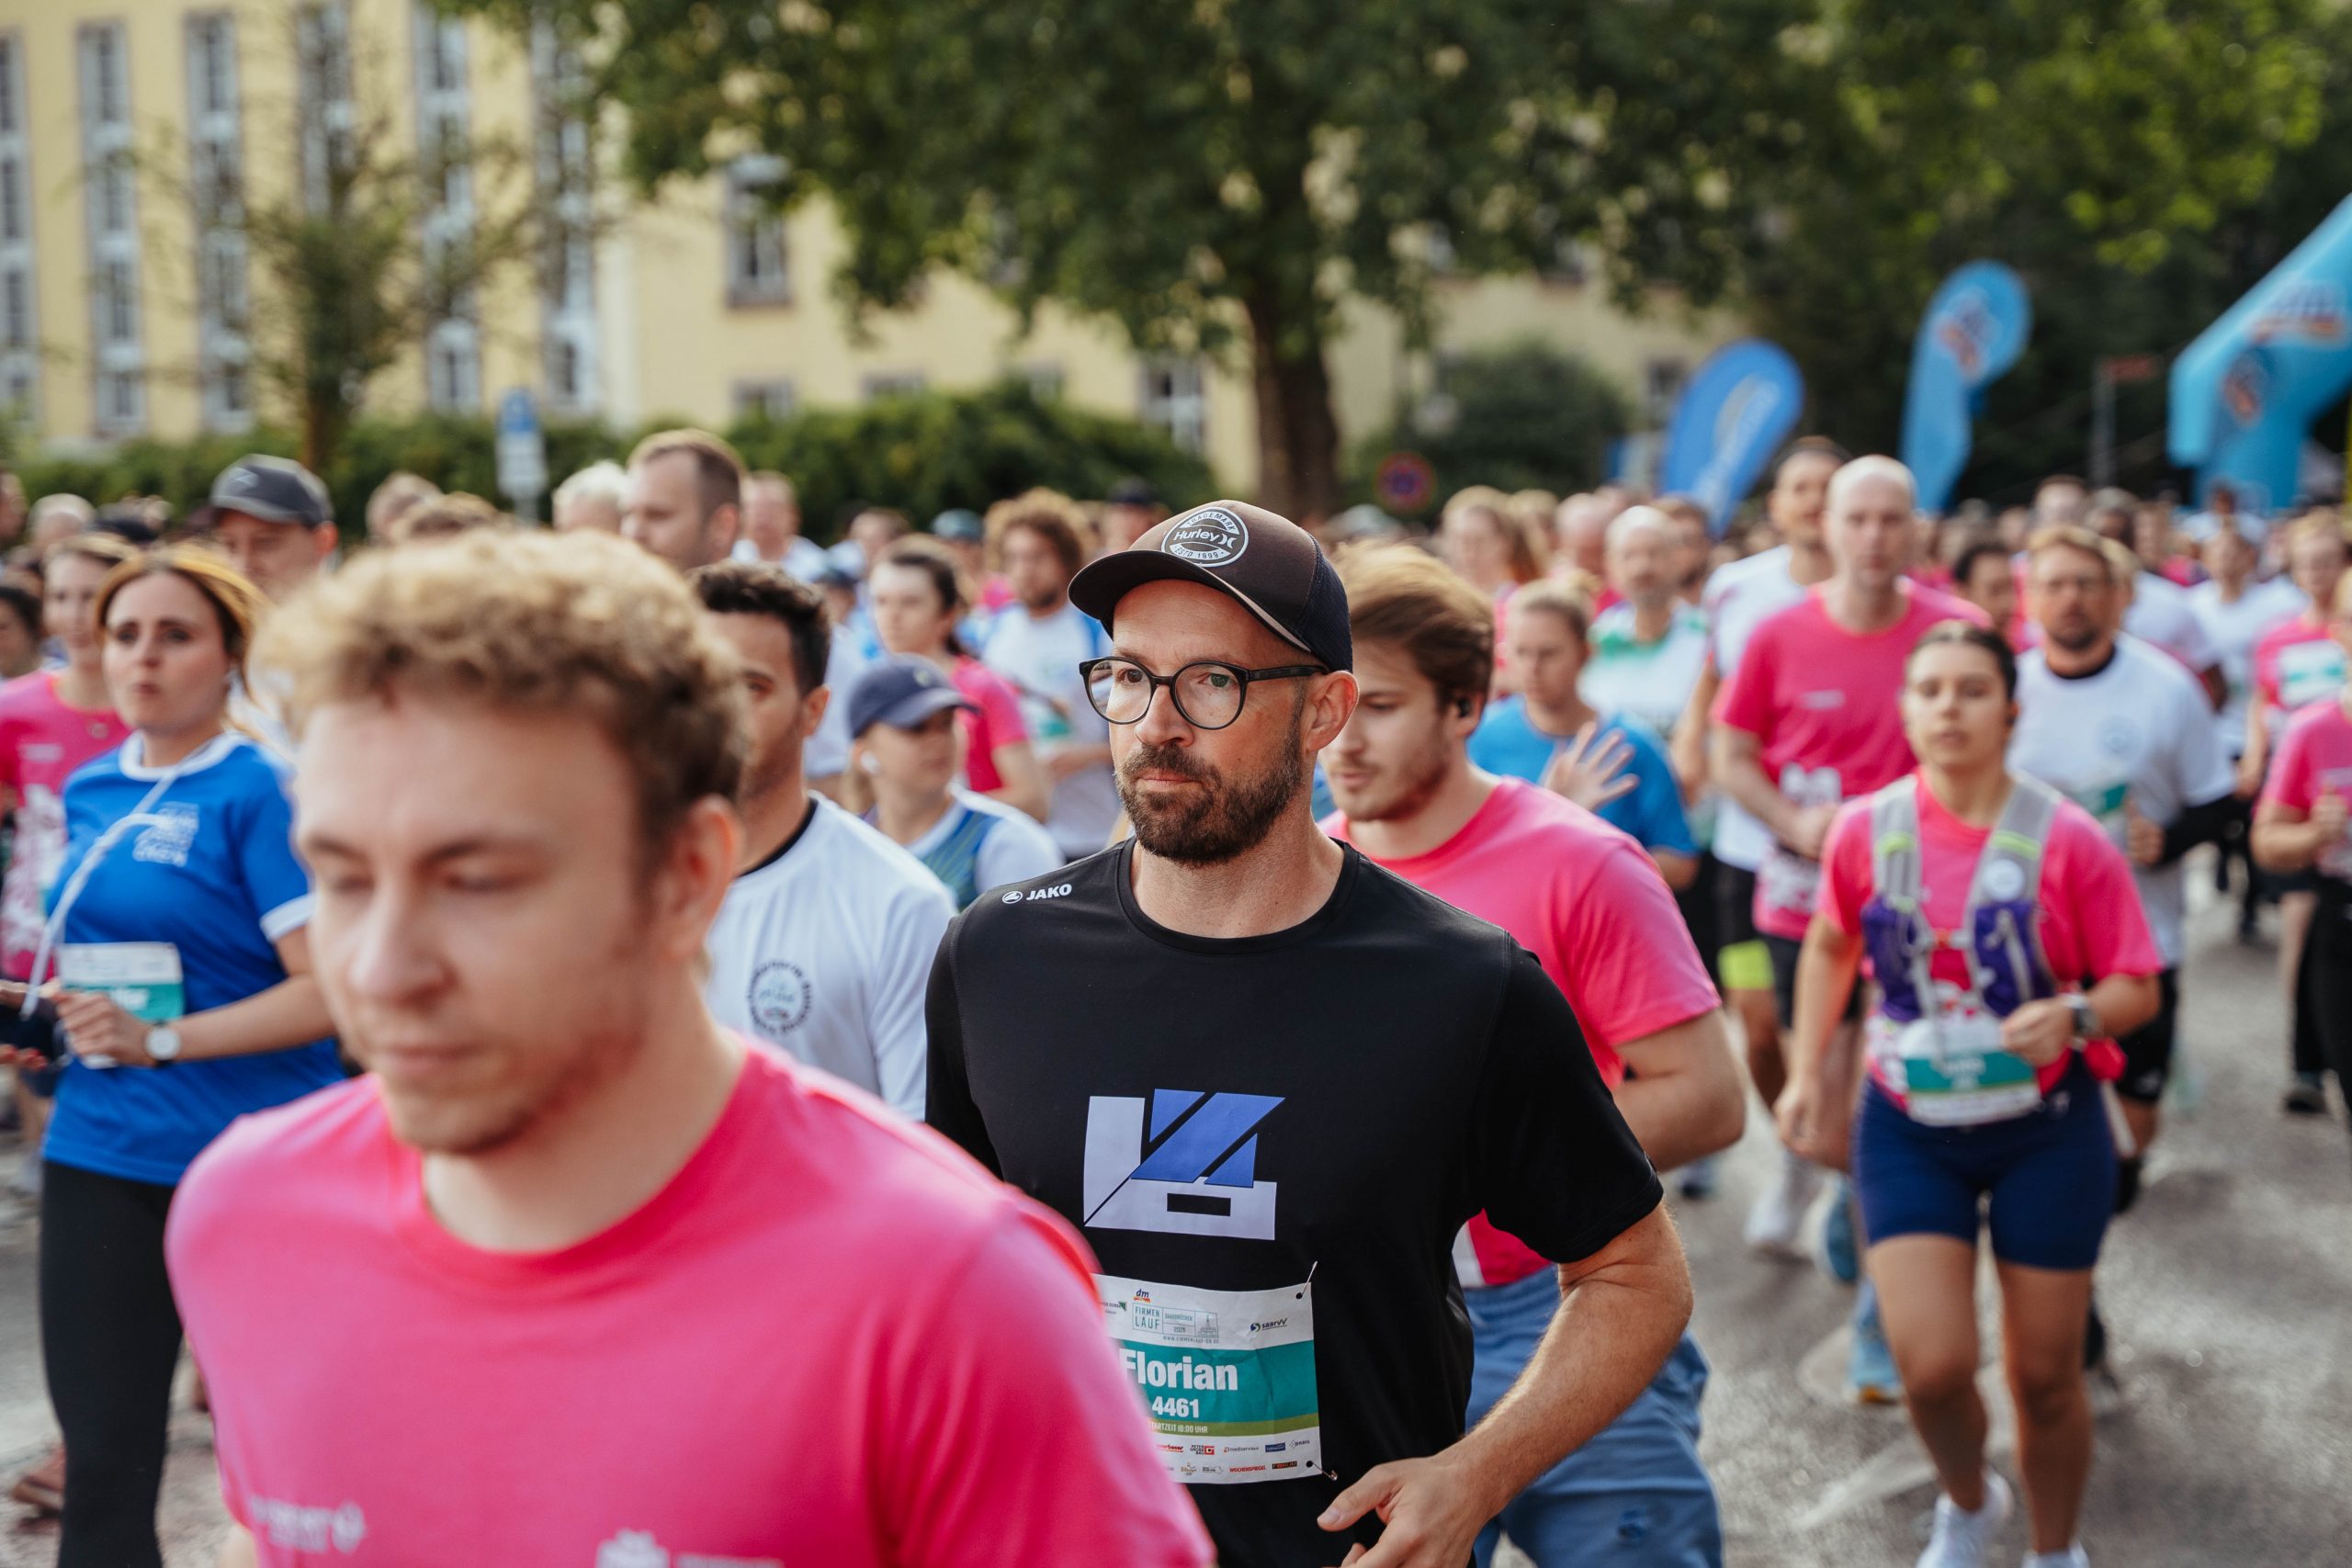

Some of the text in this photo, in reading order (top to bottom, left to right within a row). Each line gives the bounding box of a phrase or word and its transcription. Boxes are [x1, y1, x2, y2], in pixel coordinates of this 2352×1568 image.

[1187, 512, 1237, 531] TRADEMARK
[1173, 528, 1220, 542] Hurley
[1026, 884, 1072, 900] JAKO
[1136, 1289, 1149, 1298] dm
[1135, 1306, 1159, 1317] FIRMEN
[1135, 1315, 1159, 1329] LAUF
[1119, 1348, 1238, 1391] Florian
[1152, 1396, 1199, 1417] 4461
